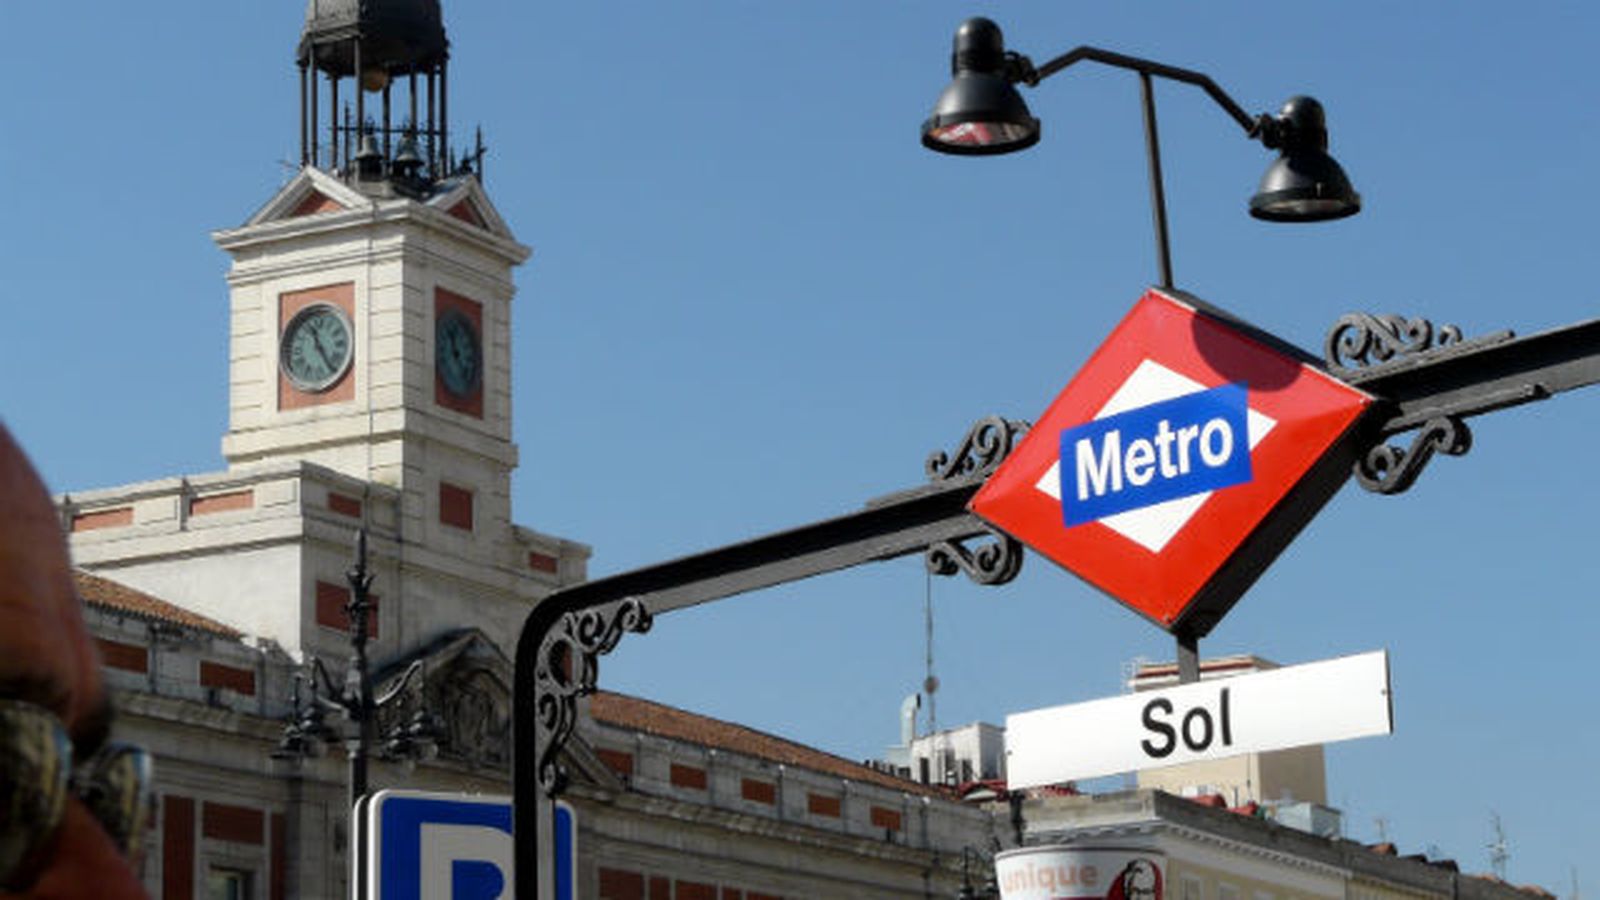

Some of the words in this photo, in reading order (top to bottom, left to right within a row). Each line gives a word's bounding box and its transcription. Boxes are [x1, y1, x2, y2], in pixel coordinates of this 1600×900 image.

[1075, 418, 1234, 501] Metro
[1141, 687, 1232, 759] Sol
[1002, 863, 1099, 892] unique
